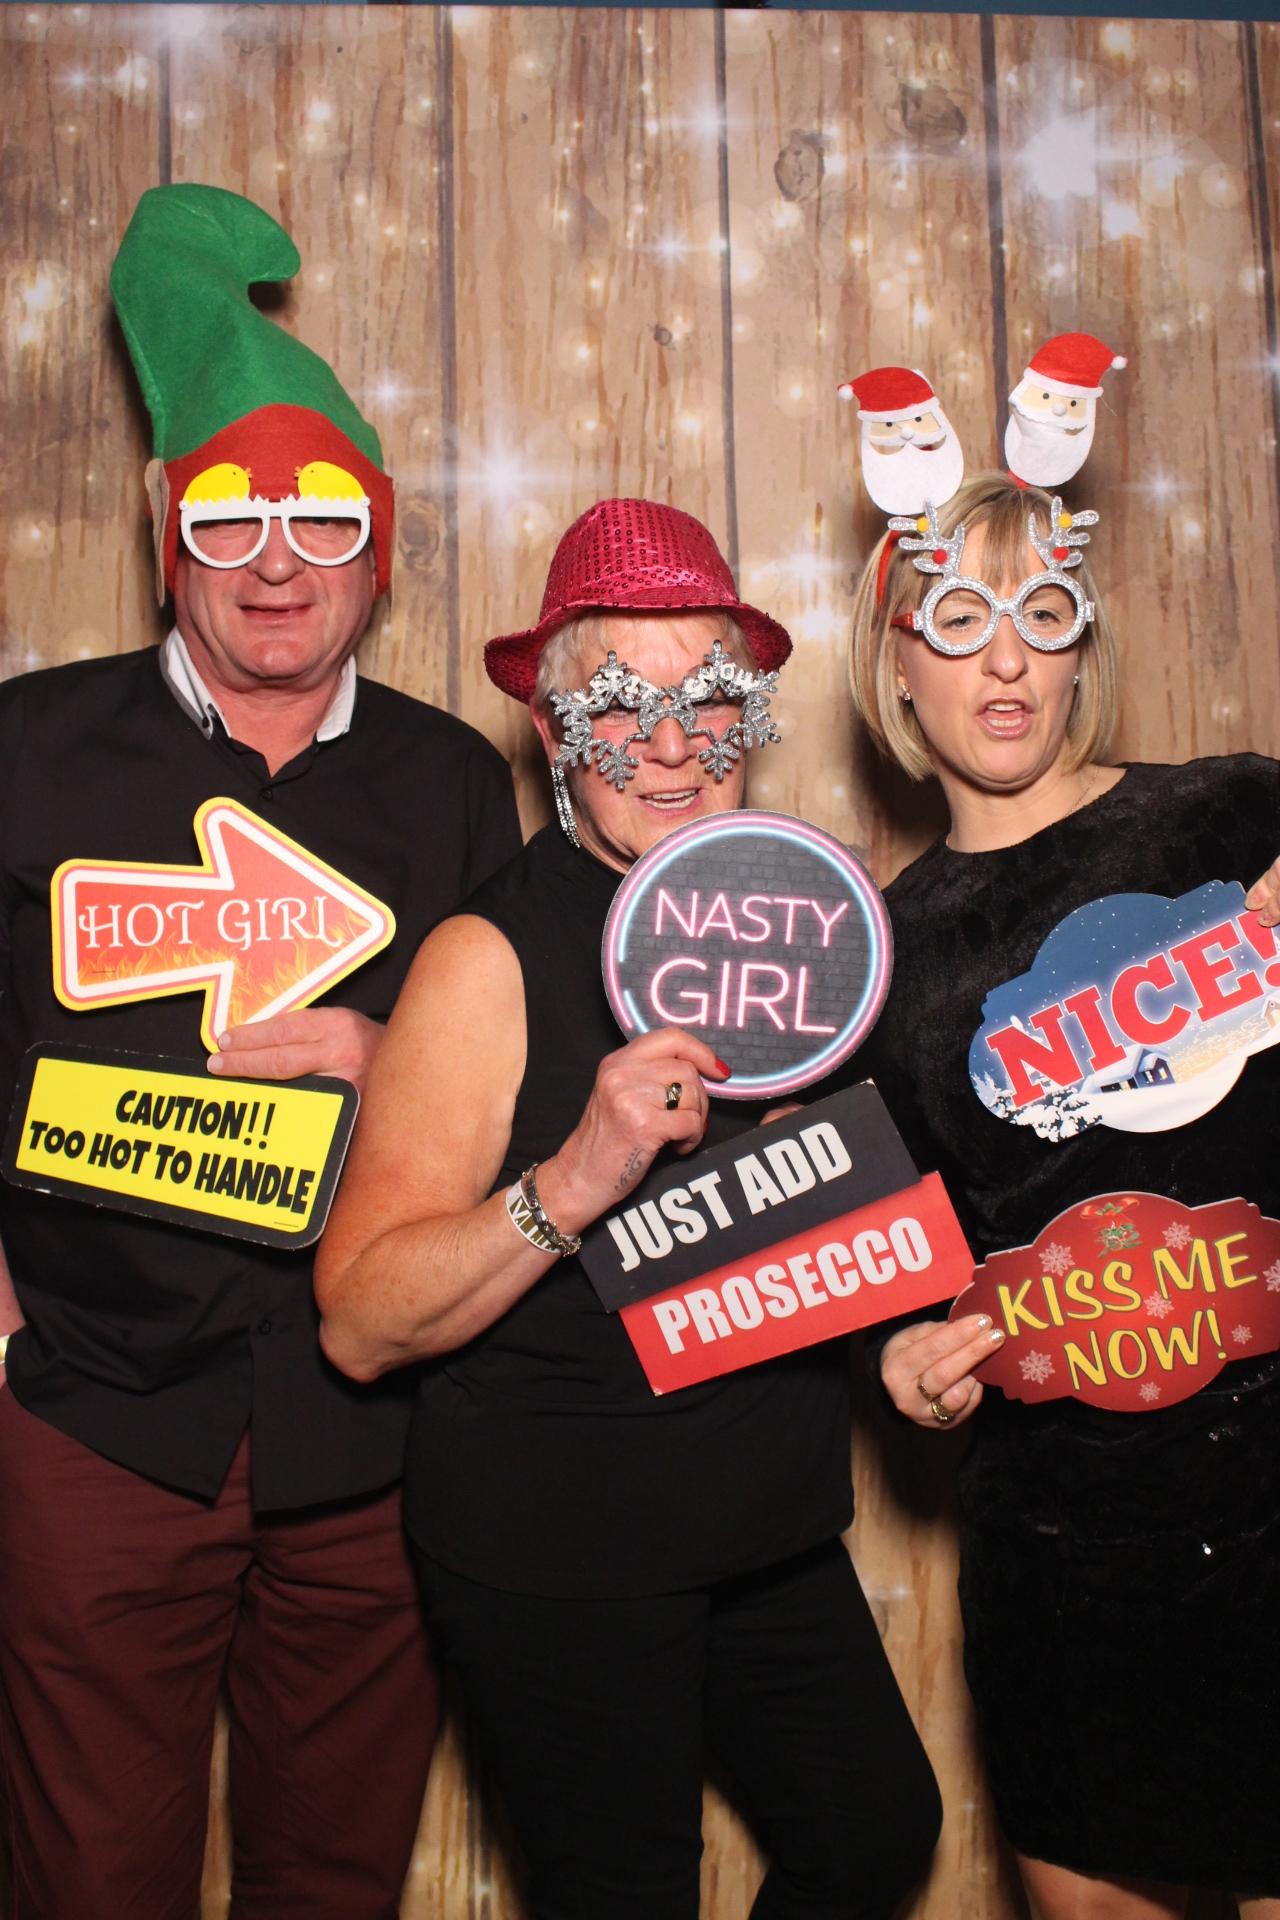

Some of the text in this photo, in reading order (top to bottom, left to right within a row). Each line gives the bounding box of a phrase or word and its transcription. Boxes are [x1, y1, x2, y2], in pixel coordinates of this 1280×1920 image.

[78, 895, 344, 950] HOT GIRL
[654, 889, 848, 946] NASTY
[650, 958, 837, 1034] GIRL
[986, 909, 1280, 1108] NICE!
[115, 1089, 277, 1150] CAUTION!!
[28, 1120, 316, 1215] TOO HOT TO HANDLE
[605, 1122, 853, 1272] JUST ADD
[652, 1217, 933, 1355] PROSECCO
[997, 1231, 1258, 1336] KISS ME
[1063, 1309, 1228, 1390] NOW!
